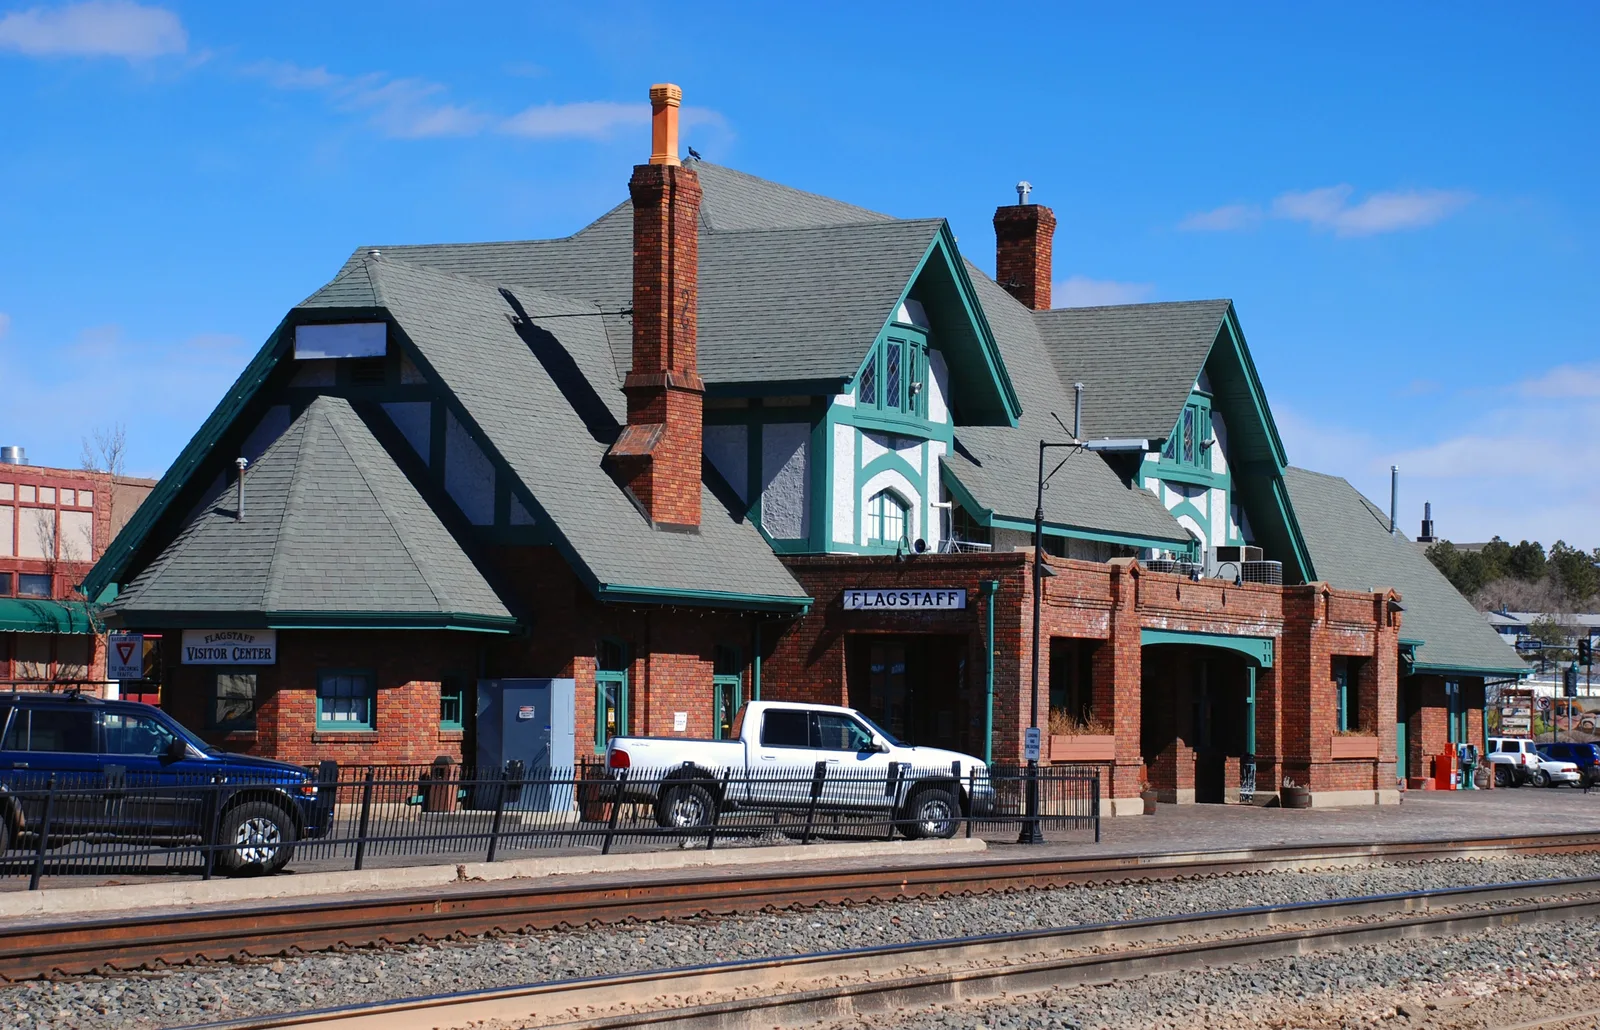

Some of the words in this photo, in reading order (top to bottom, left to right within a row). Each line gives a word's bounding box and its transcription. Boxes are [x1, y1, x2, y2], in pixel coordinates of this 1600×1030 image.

[852, 592, 958, 606] FLAGSTAFF
[204, 632, 255, 644] FLAGSTAFF
[186, 646, 228, 661] VISITOR
[232, 646, 272, 662] CENTER
